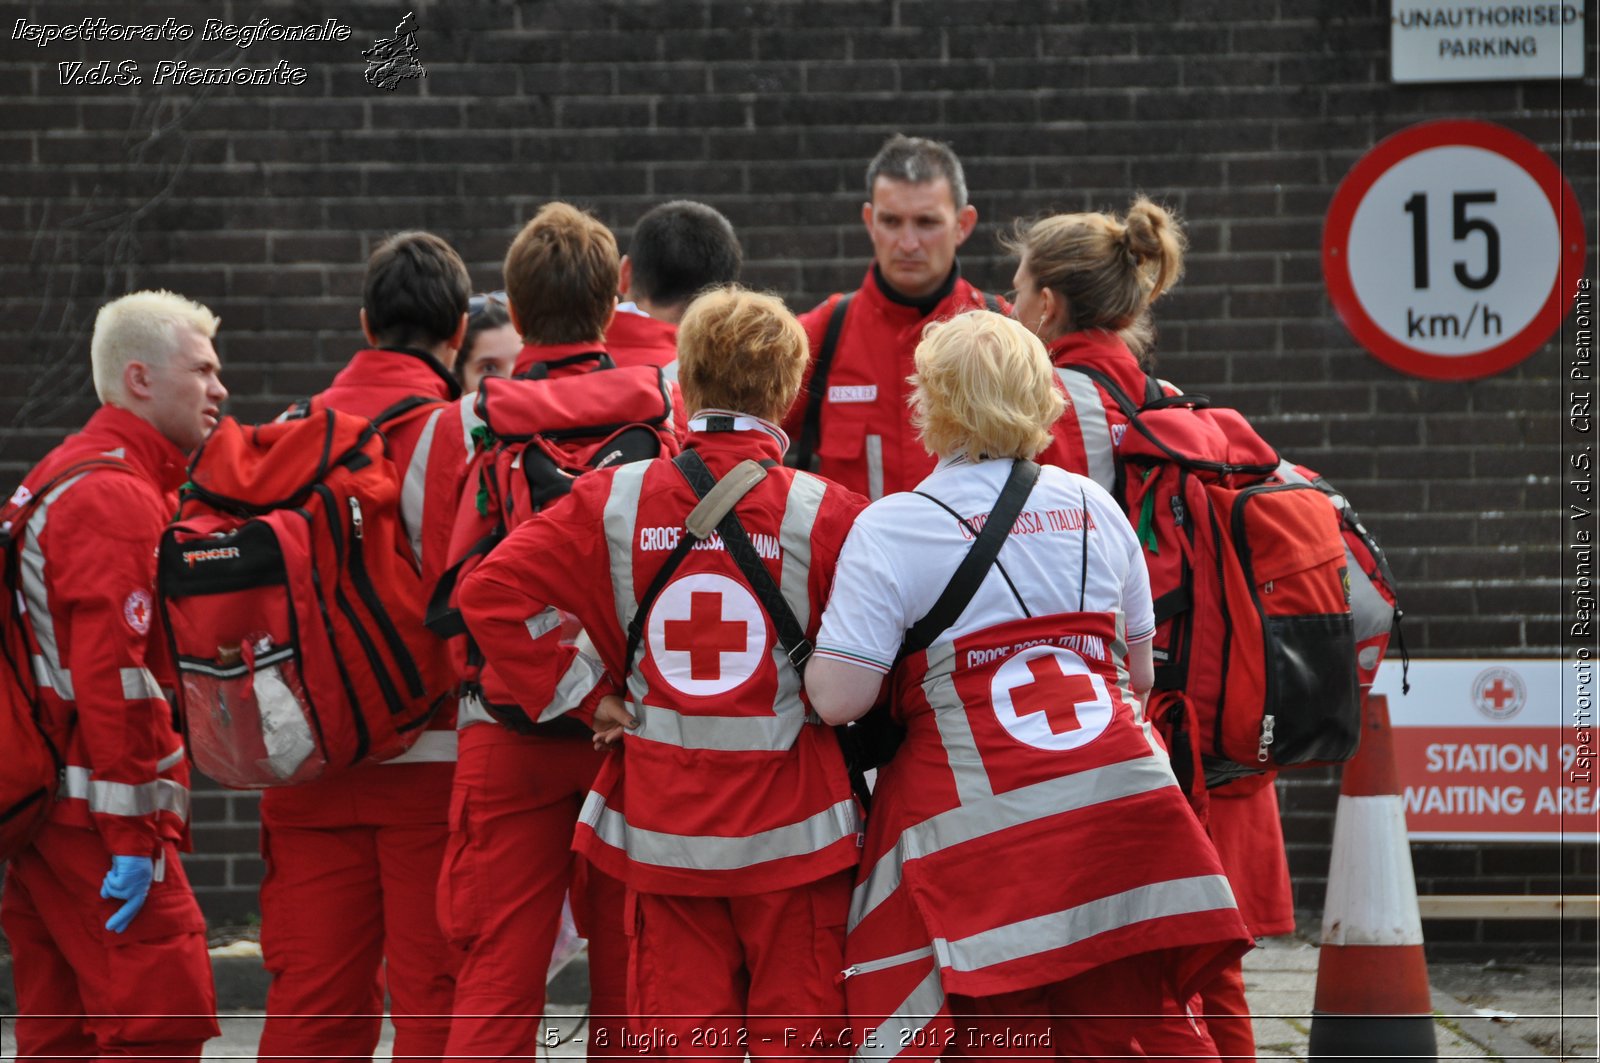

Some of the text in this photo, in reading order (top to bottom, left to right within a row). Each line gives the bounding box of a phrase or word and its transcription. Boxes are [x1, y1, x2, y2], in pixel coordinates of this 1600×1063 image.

[1400, 5, 1577, 28] UNAUTHORISED
[1439, 36, 1537, 57] PARKING
[1403, 190, 1501, 290] 15
[1407, 303, 1502, 339] km/h
[183, 547, 240, 562] SPENCER
[1426, 743, 1548, 772] STATION
[1402, 786, 1526, 815] WAITING
